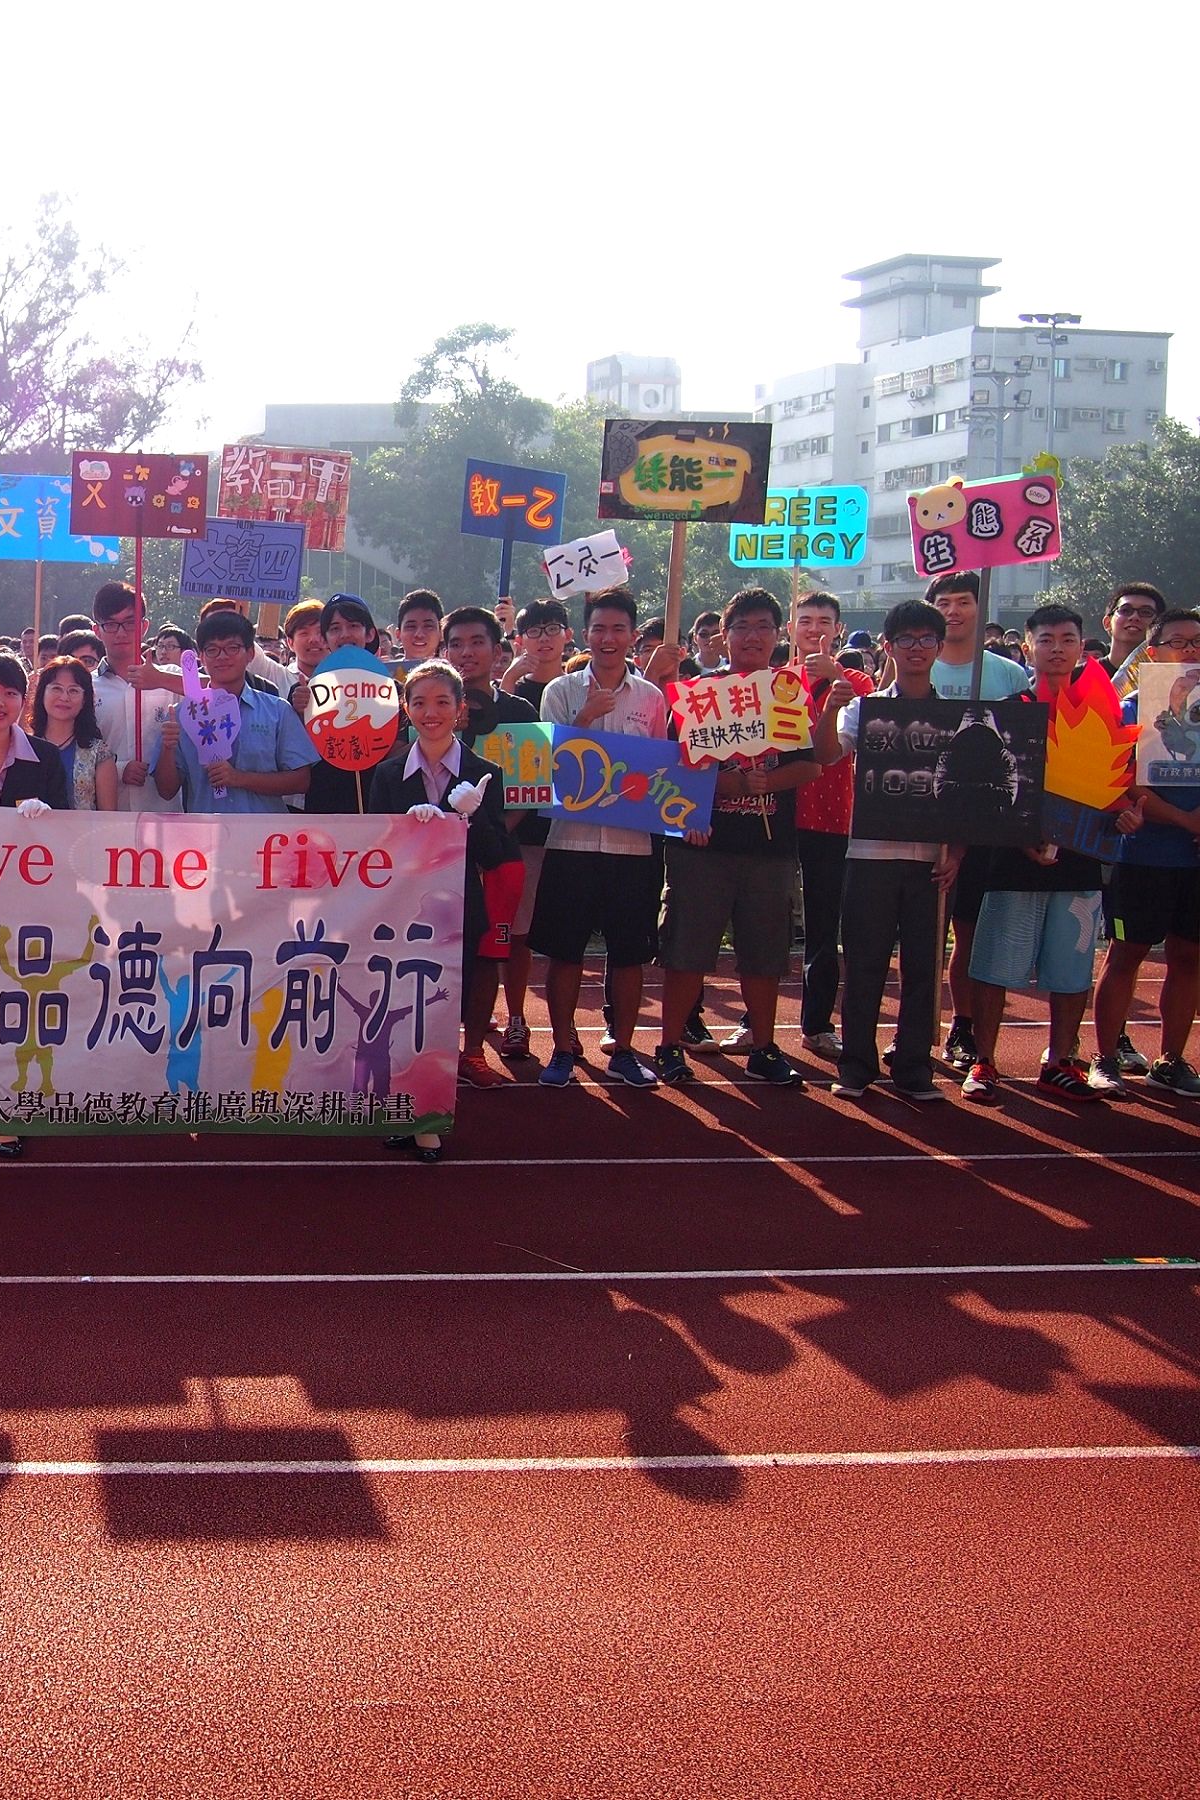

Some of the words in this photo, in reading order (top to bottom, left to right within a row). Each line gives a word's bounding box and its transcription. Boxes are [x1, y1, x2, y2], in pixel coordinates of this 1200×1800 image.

[266, 479, 306, 499] EDU
[470, 473, 557, 530] 教一乙
[762, 496, 838, 527] REE
[189, 529, 298, 583] 文資四
[734, 532, 865, 561] NERGY
[311, 682, 393, 707] Drama
[685, 682, 761, 724] 材料
[344, 700, 359, 721] 2
[324, 734, 390, 761] 戲劇二
[505, 785, 551, 805] AMA
[102, 846, 209, 890] me
[255, 833, 393, 890] five
